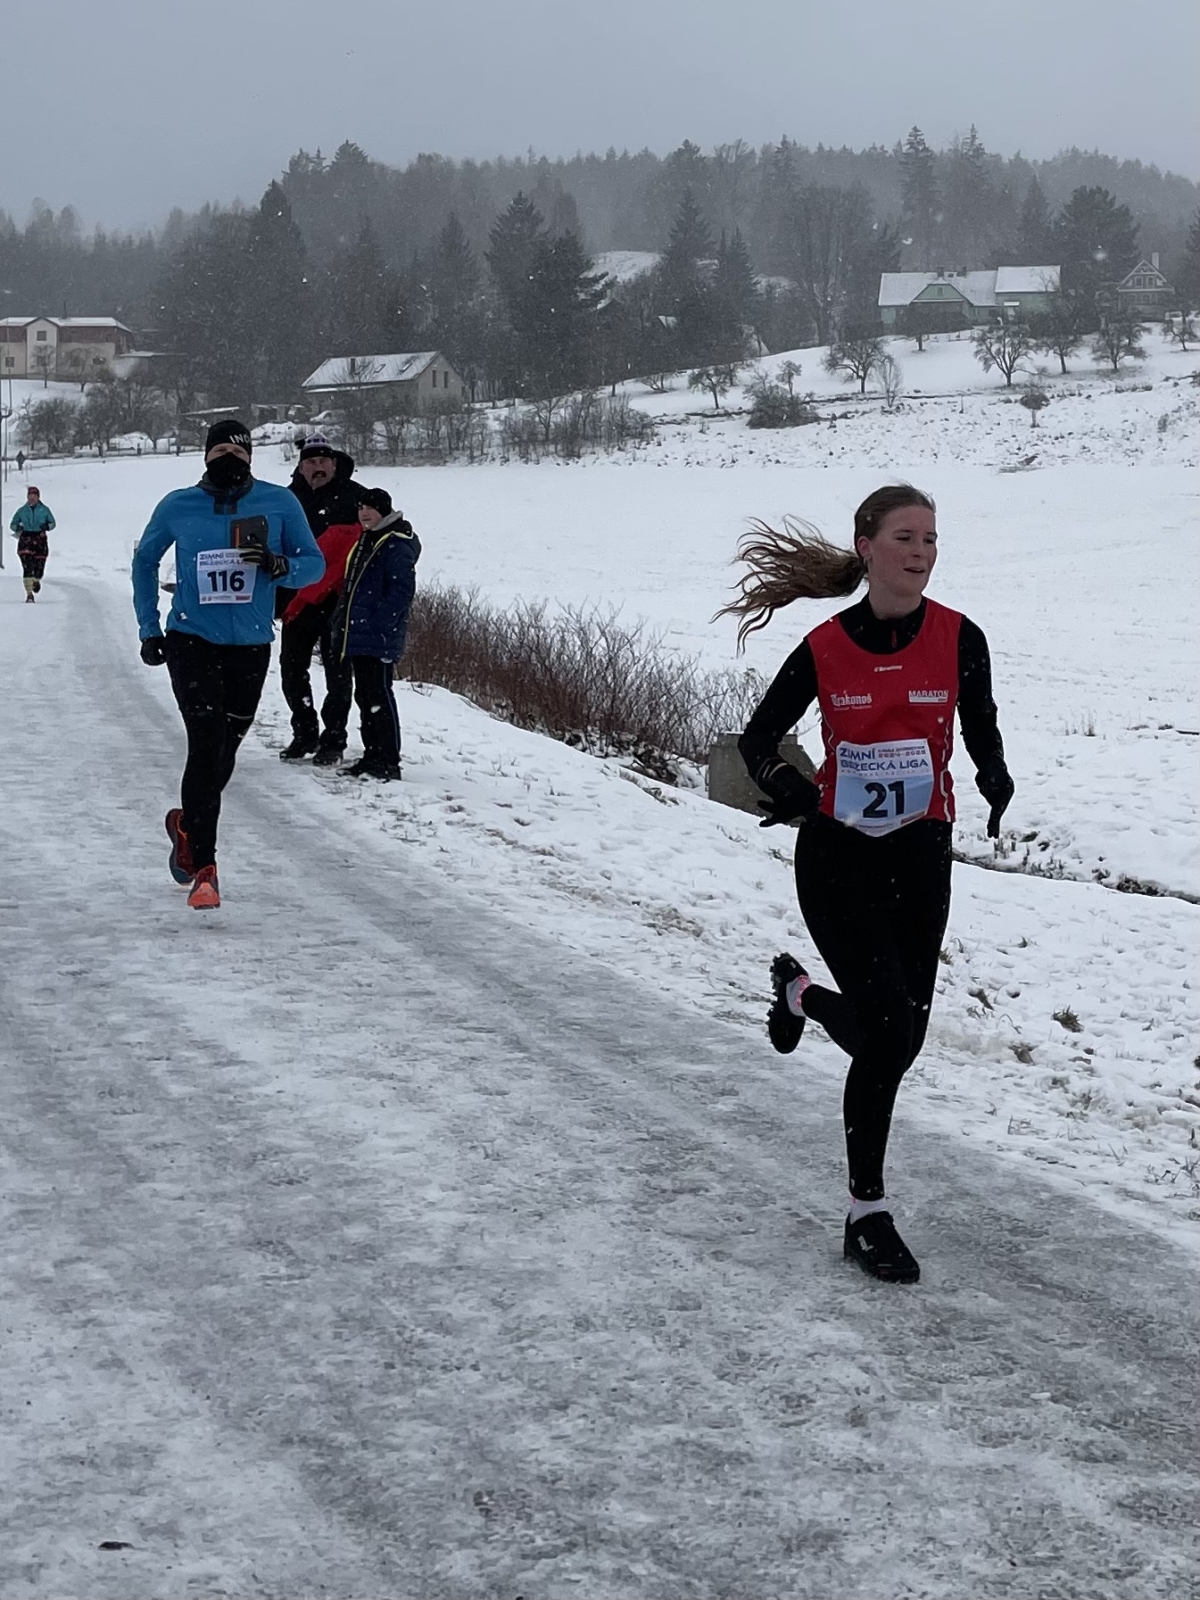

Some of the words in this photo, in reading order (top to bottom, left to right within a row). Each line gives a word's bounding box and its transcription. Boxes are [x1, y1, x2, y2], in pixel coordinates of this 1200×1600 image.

[207, 570, 245, 592] 116
[908, 690, 949, 699] MARATON
[839, 747, 876, 761] ZIMNÍ
[899, 758, 929, 770] LIGA
[862, 780, 905, 818] 21
